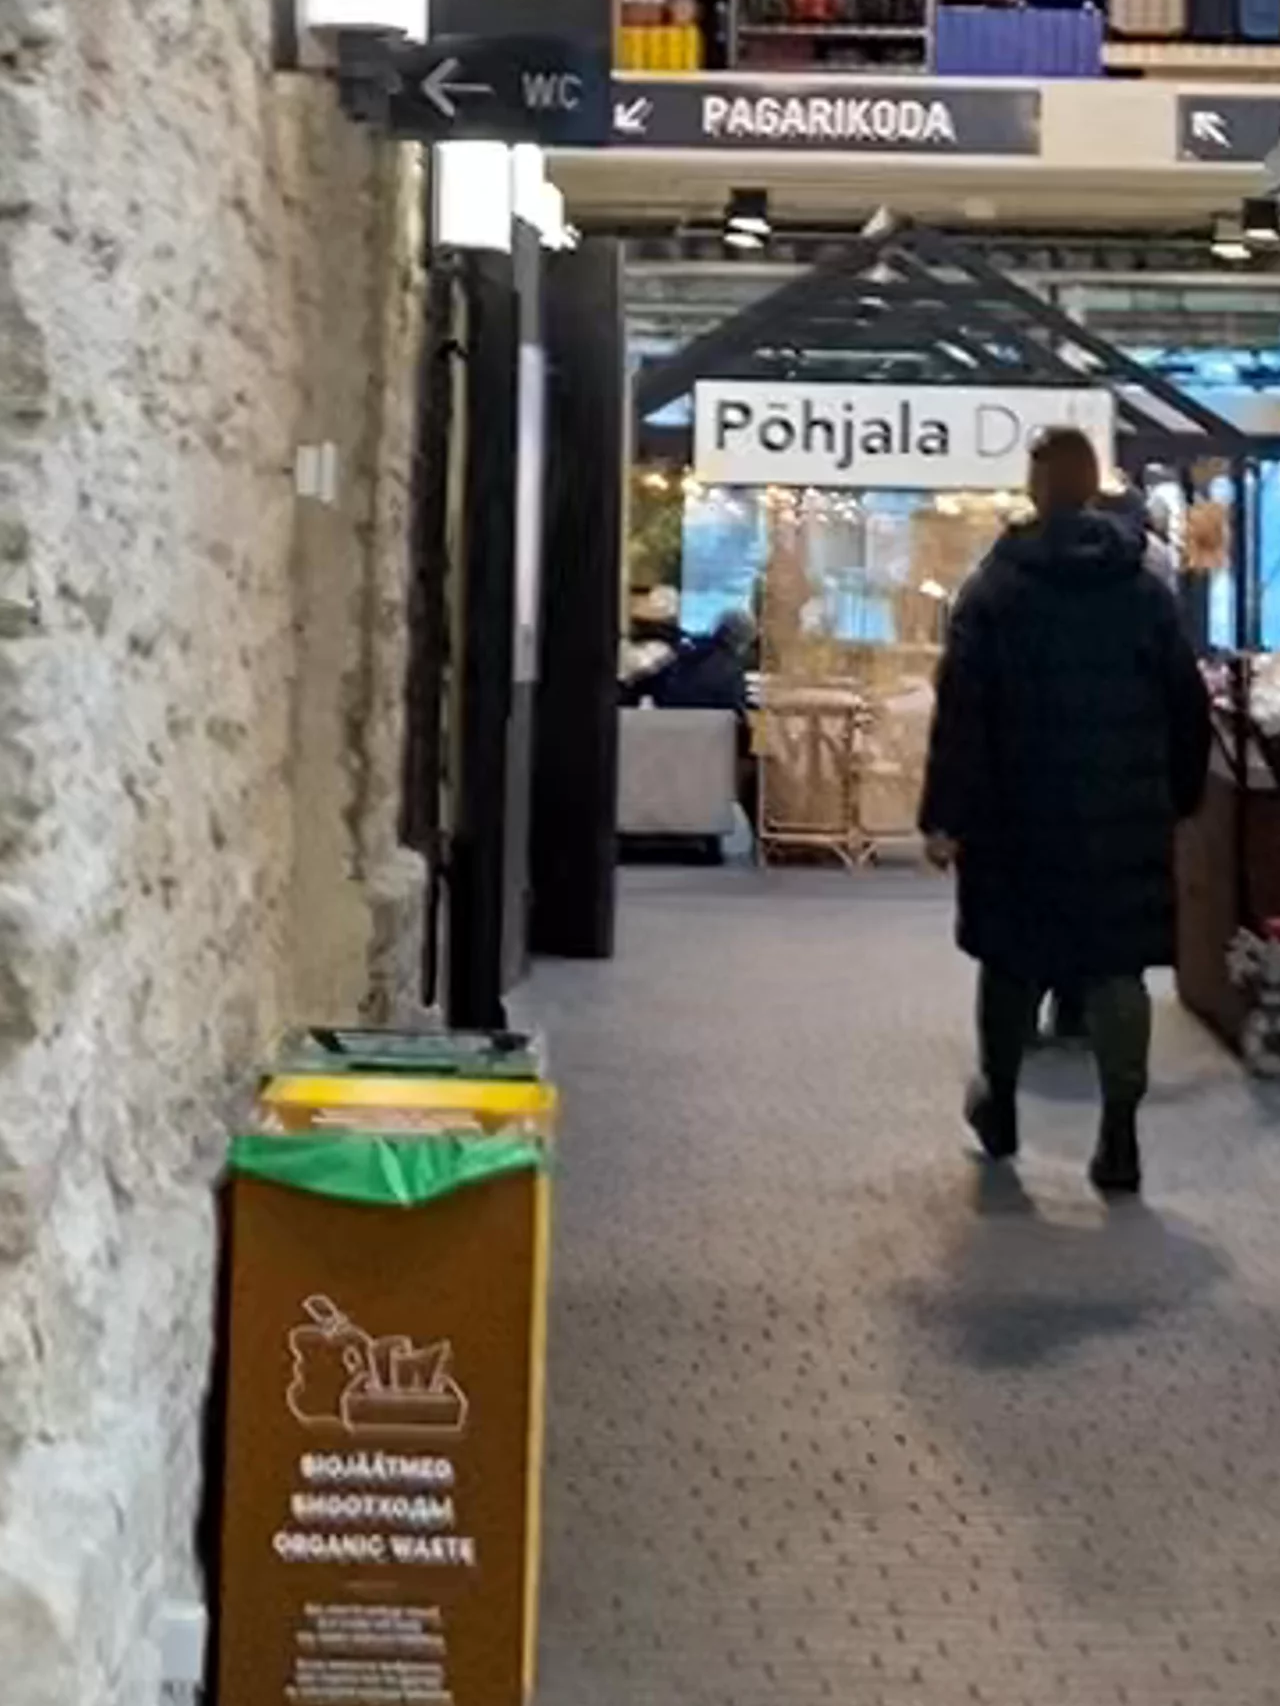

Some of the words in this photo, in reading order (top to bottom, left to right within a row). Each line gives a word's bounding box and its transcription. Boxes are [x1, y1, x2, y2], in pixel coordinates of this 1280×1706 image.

[522, 71, 582, 110] WC
[701, 95, 957, 143] PAGARIKODA
[714, 399, 951, 469] Põhjala
[299, 1450, 455, 1484] BIOJÄÄTMED
[272, 1532, 386, 1562] ORGANIC
[389, 1535, 476, 1566] WASTE
